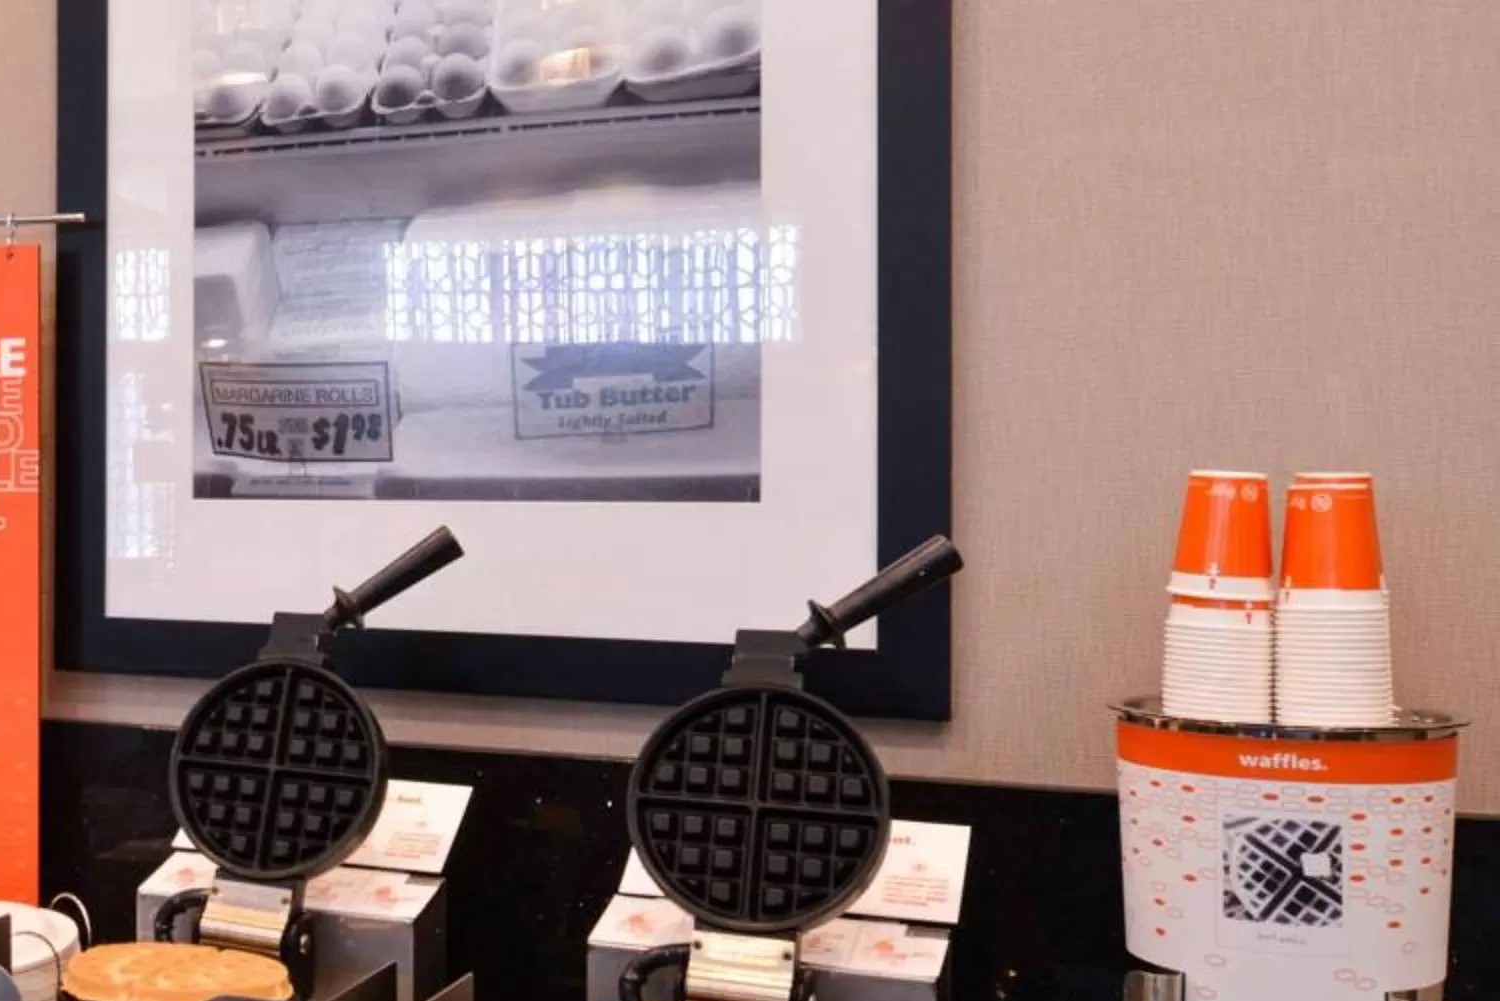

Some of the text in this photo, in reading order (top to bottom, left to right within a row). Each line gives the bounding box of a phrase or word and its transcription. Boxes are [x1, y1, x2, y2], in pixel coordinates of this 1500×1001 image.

[537, 385, 696, 410] Tub Butter
[1238, 752, 1330, 772] waffles.
